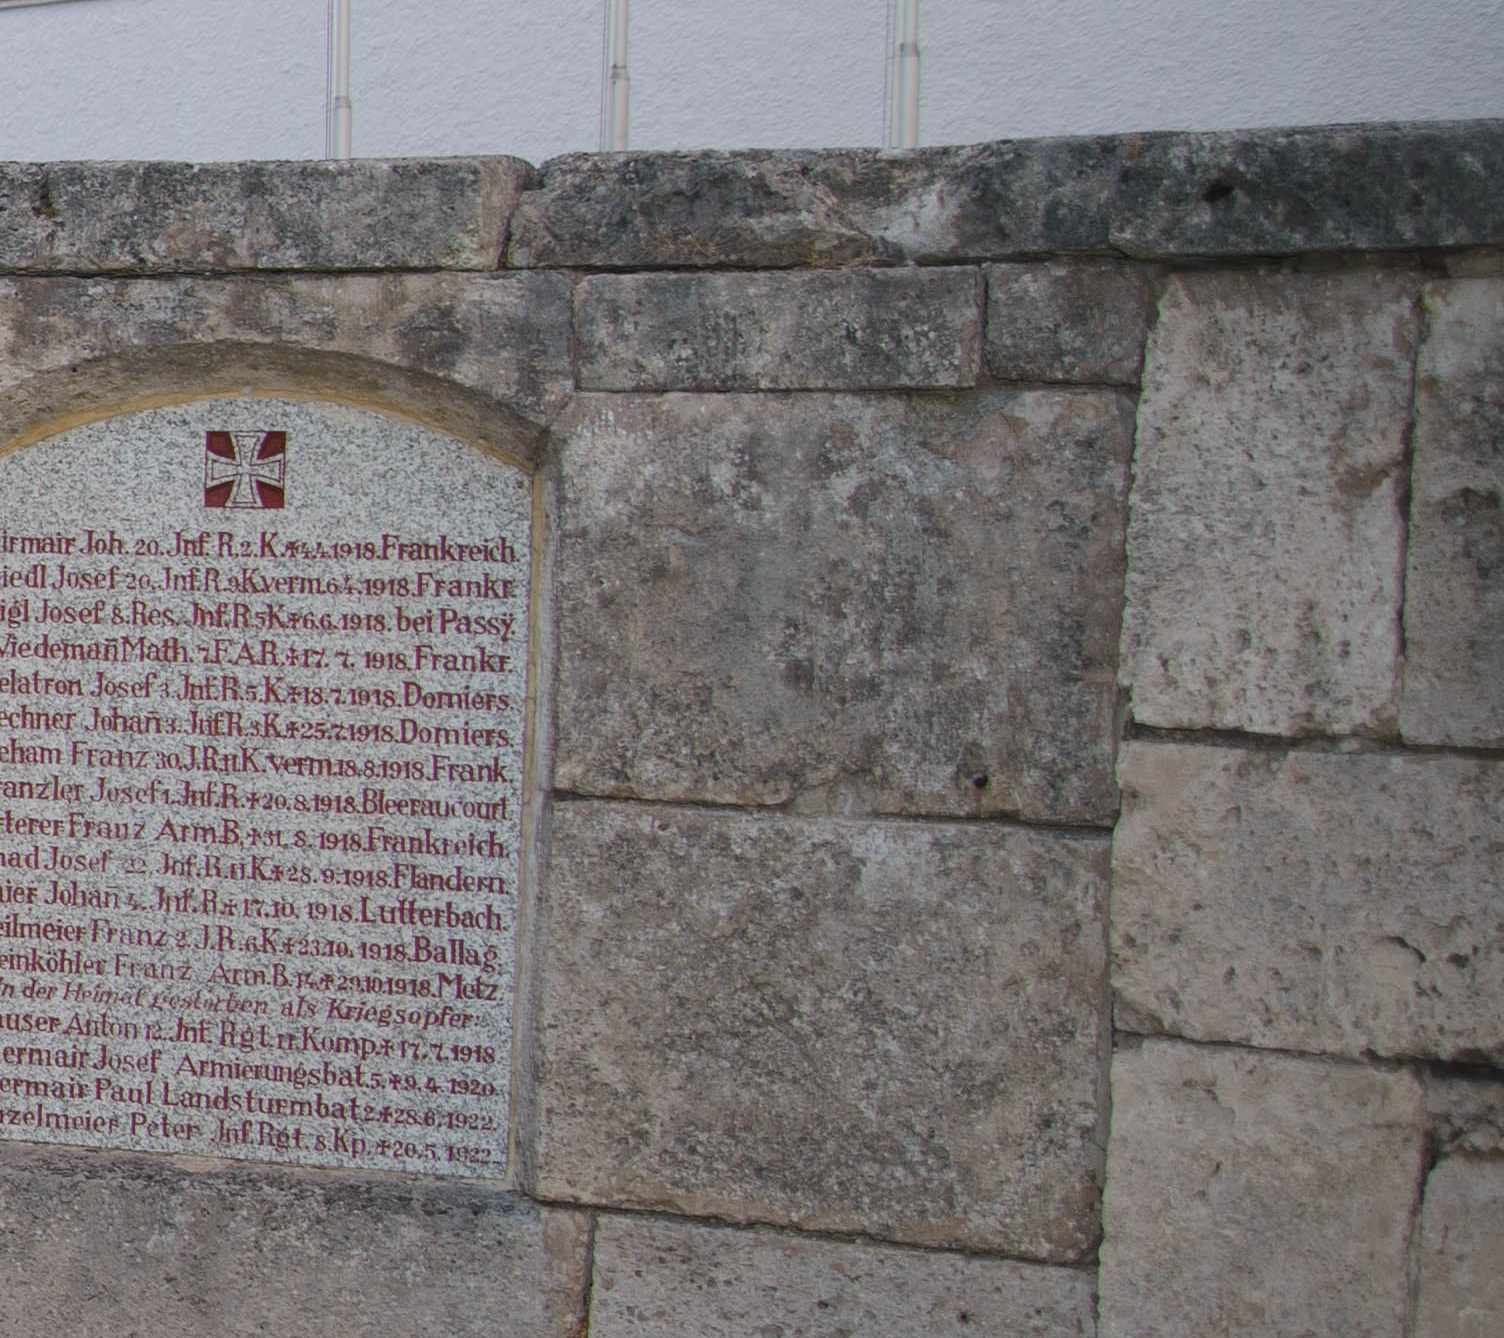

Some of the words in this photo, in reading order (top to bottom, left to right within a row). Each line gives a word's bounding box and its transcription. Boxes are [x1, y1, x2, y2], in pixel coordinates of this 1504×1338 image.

[51, 565, 120, 590] Josef
[34, 599, 106, 625] Josef
[394, 605, 434, 633] bei
[89, 671, 157, 698] Josef
[71, 741, 150, 769] Franz
[89, 777, 162, 805] Josef
[68, 812, 148, 840] Franz
[44, 846, 112, 873] Josef
[91, 918, 168, 947] Franz
[114, 953, 192, 981] Franz
[22, 979, 57, 1001] der
[63, 981, 144, 1006] Heimat
[149, 987, 268, 1015] gestorben
[281, 996, 316, 1018] als
[62, 1012, 138, 1040] Anton
[92, 1044, 163, 1074] Josef
[95, 1078, 152, 1105] Paul
[130, 1112, 200, 1141] Peter
